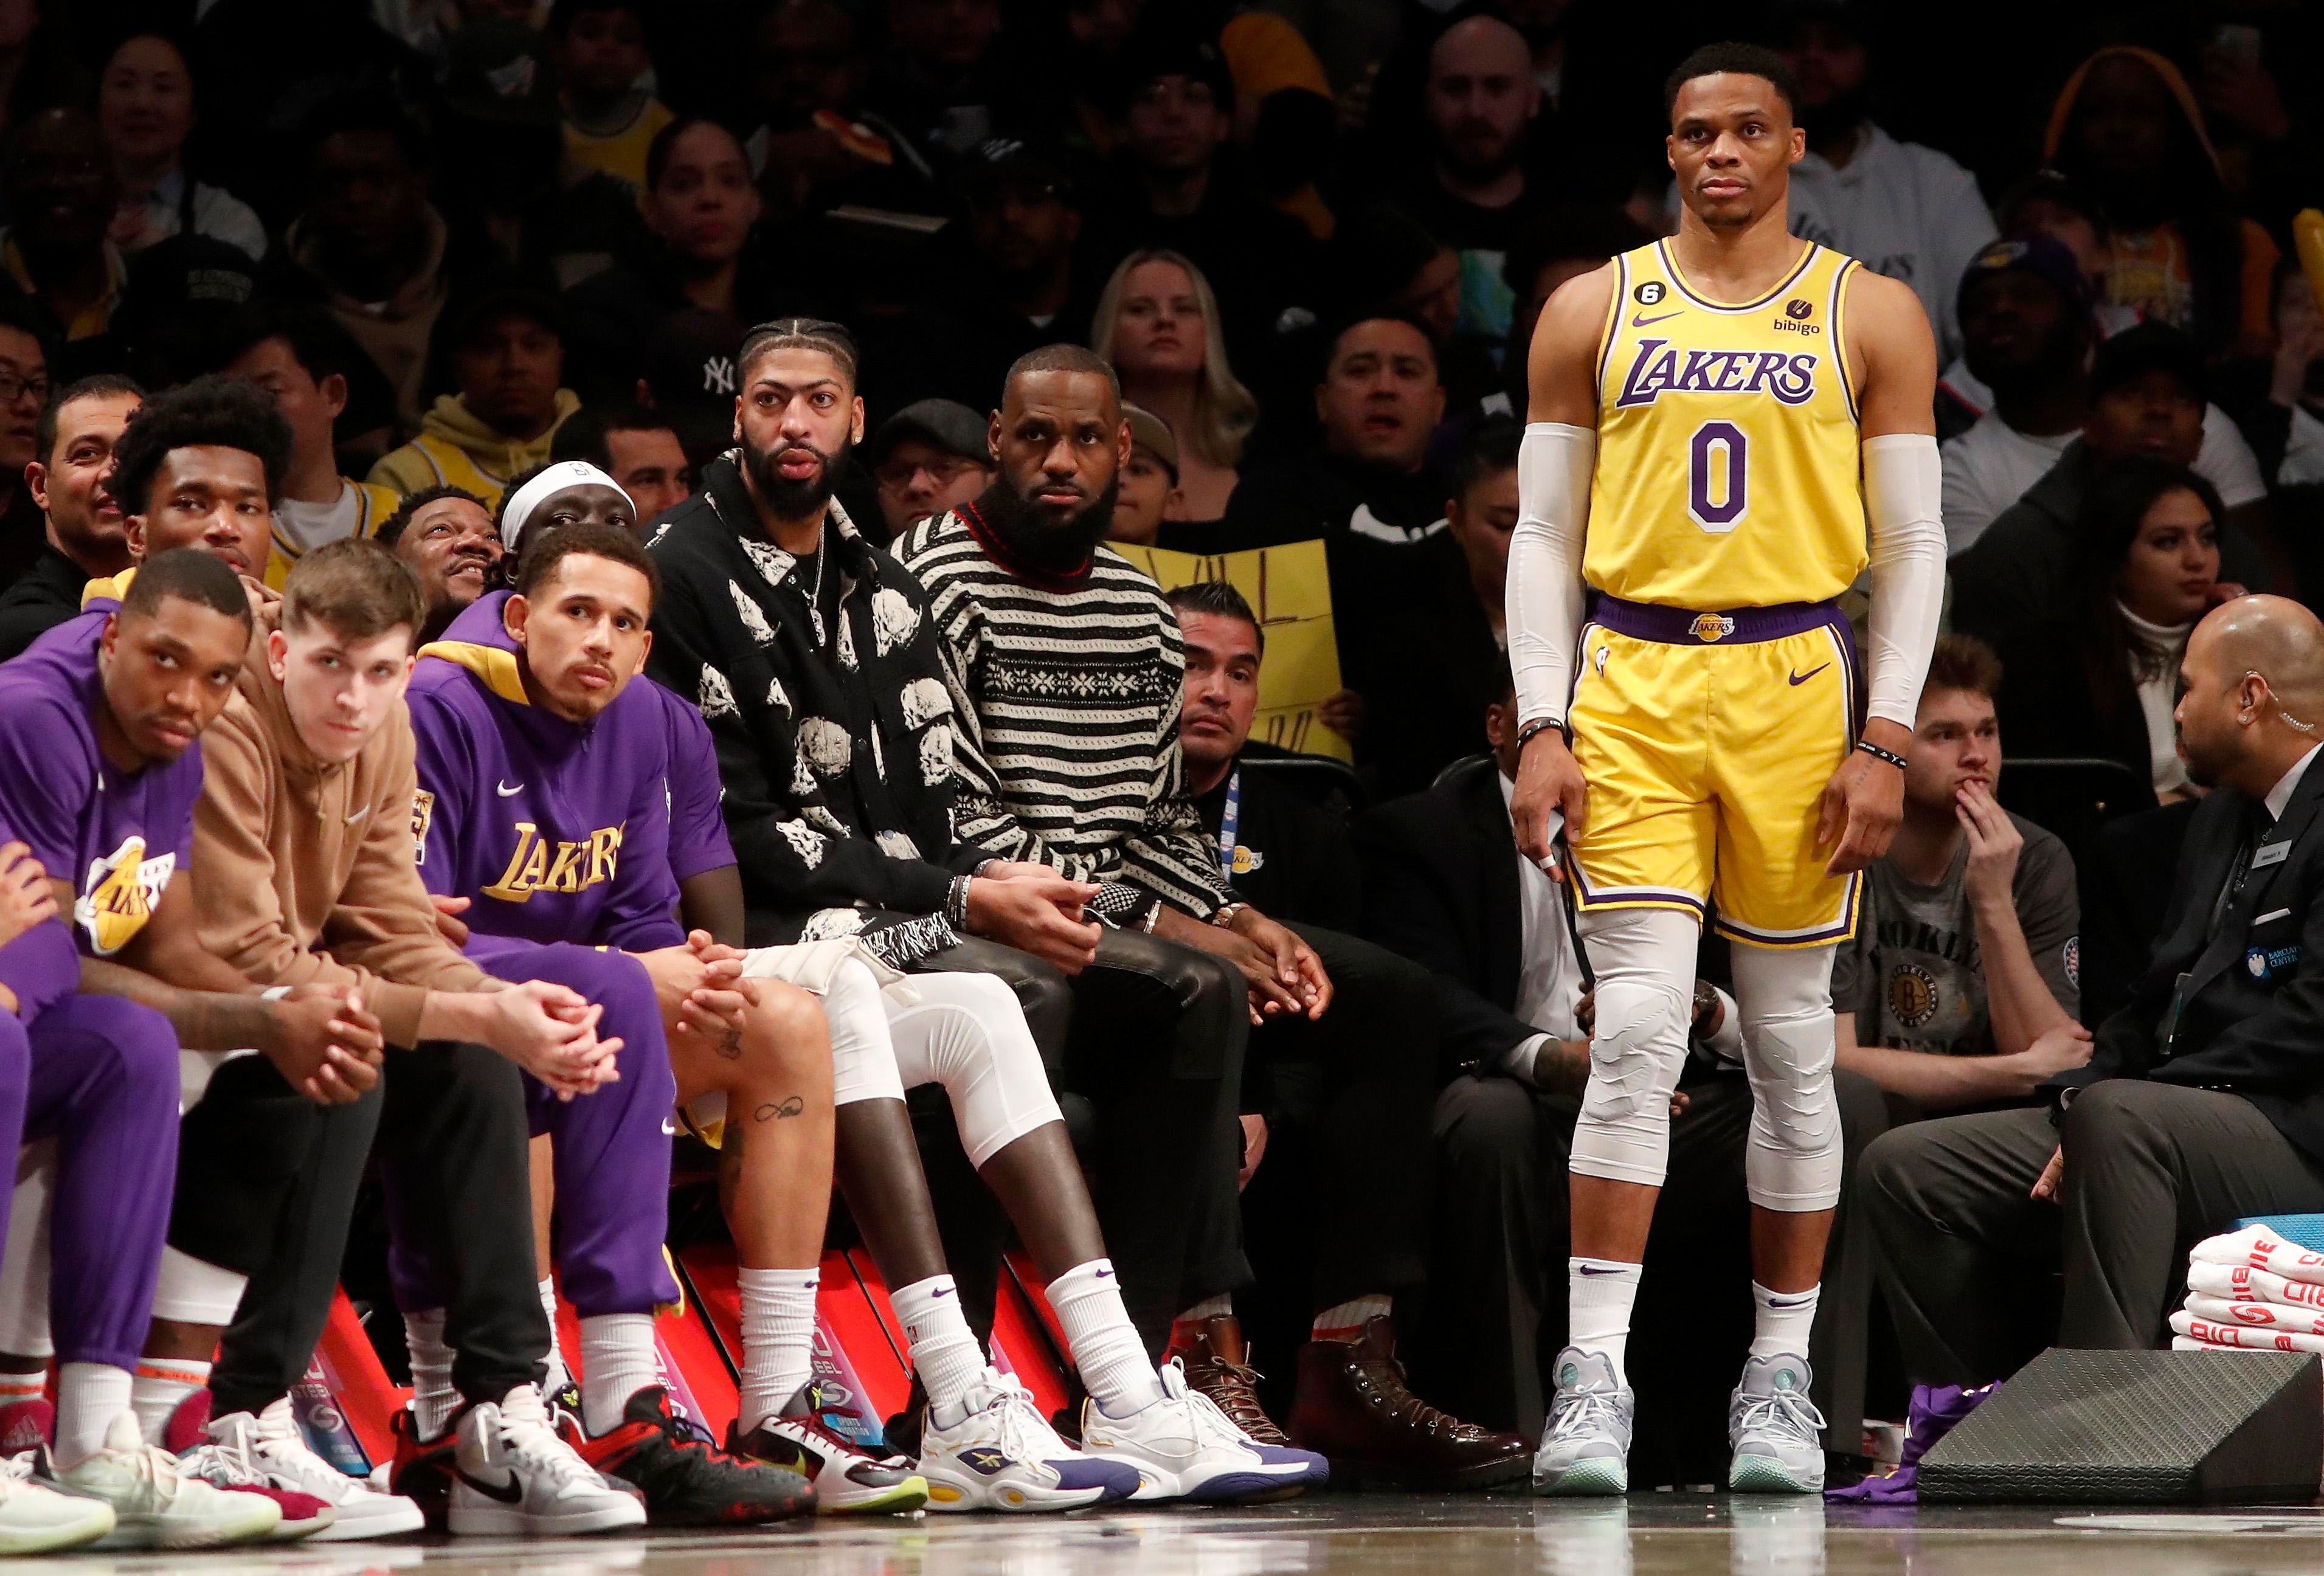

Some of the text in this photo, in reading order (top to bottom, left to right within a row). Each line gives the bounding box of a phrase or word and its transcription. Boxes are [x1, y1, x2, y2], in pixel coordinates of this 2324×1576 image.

[1641, 283, 1659, 304] 6
[1773, 319, 1820, 336] bibigo
[1615, 337, 1820, 409] LAKERS
[1688, 419, 1749, 533] 0
[1689, 617, 1735, 635] LAKERS
[2268, 946, 2299, 960] BARCLAY
